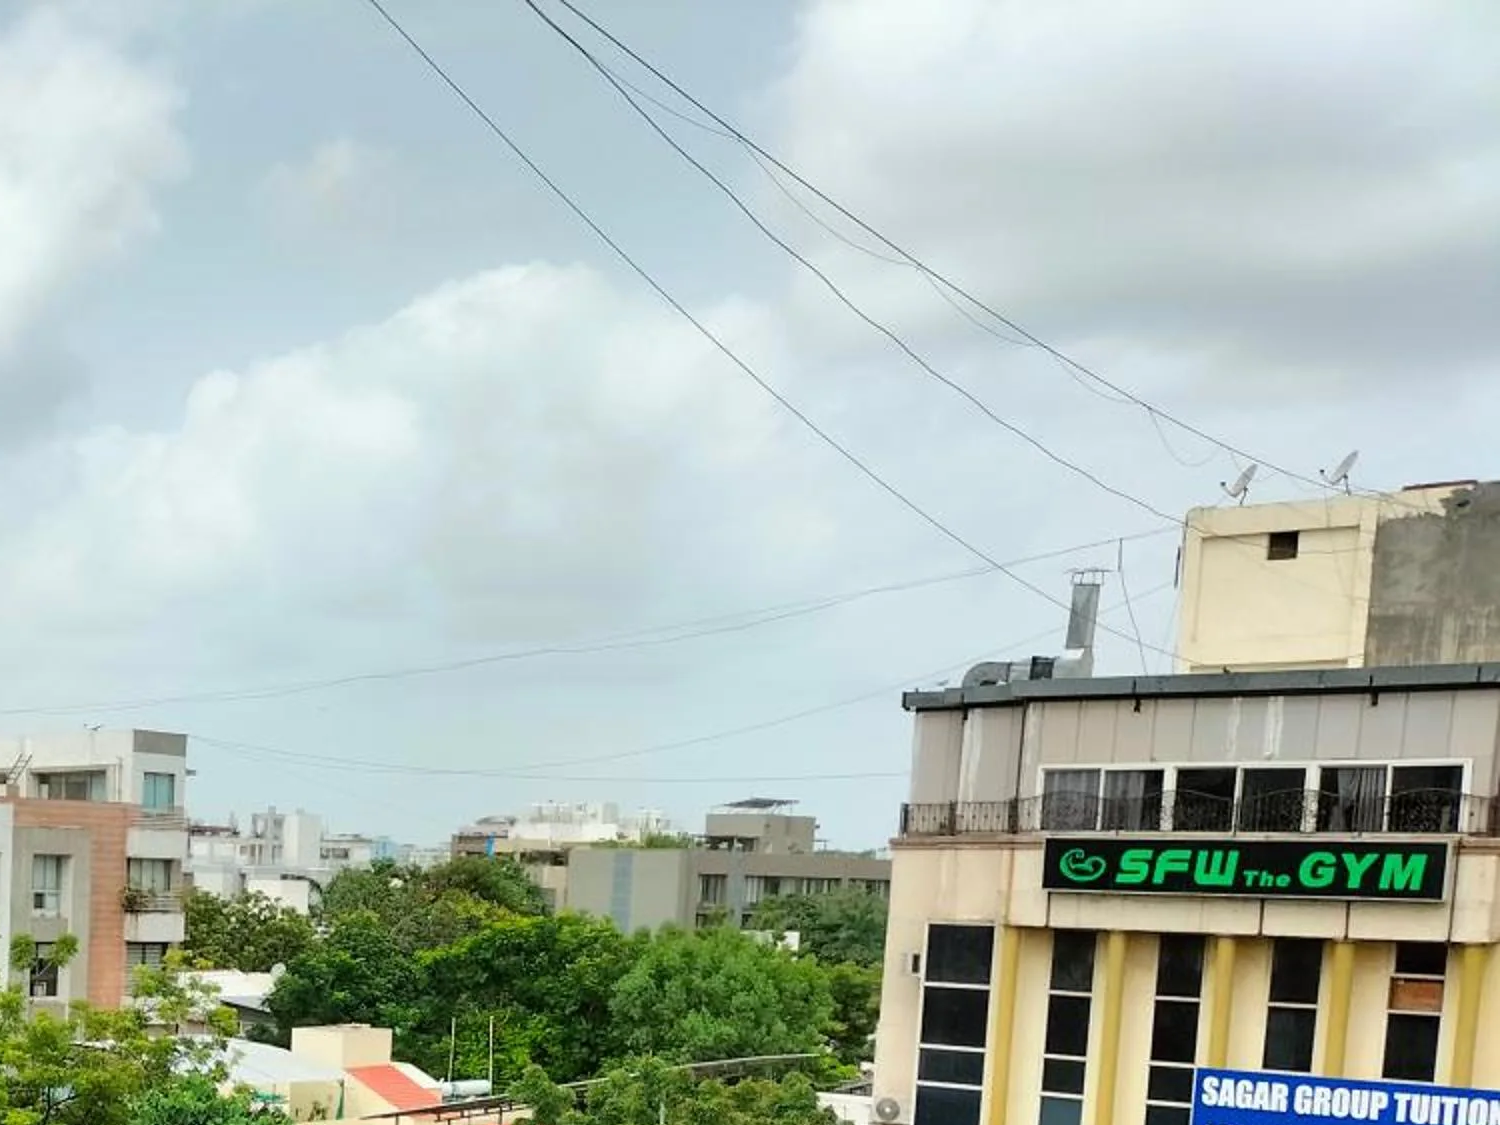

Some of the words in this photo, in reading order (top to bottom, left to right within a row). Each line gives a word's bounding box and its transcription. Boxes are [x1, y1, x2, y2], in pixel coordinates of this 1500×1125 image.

[1115, 849, 1240, 886] SFW
[1243, 870, 1291, 888] The
[1300, 851, 1428, 892] GYM
[1202, 1076, 1289, 1113] SAGAR
[1294, 1084, 1388, 1121] GROUP
